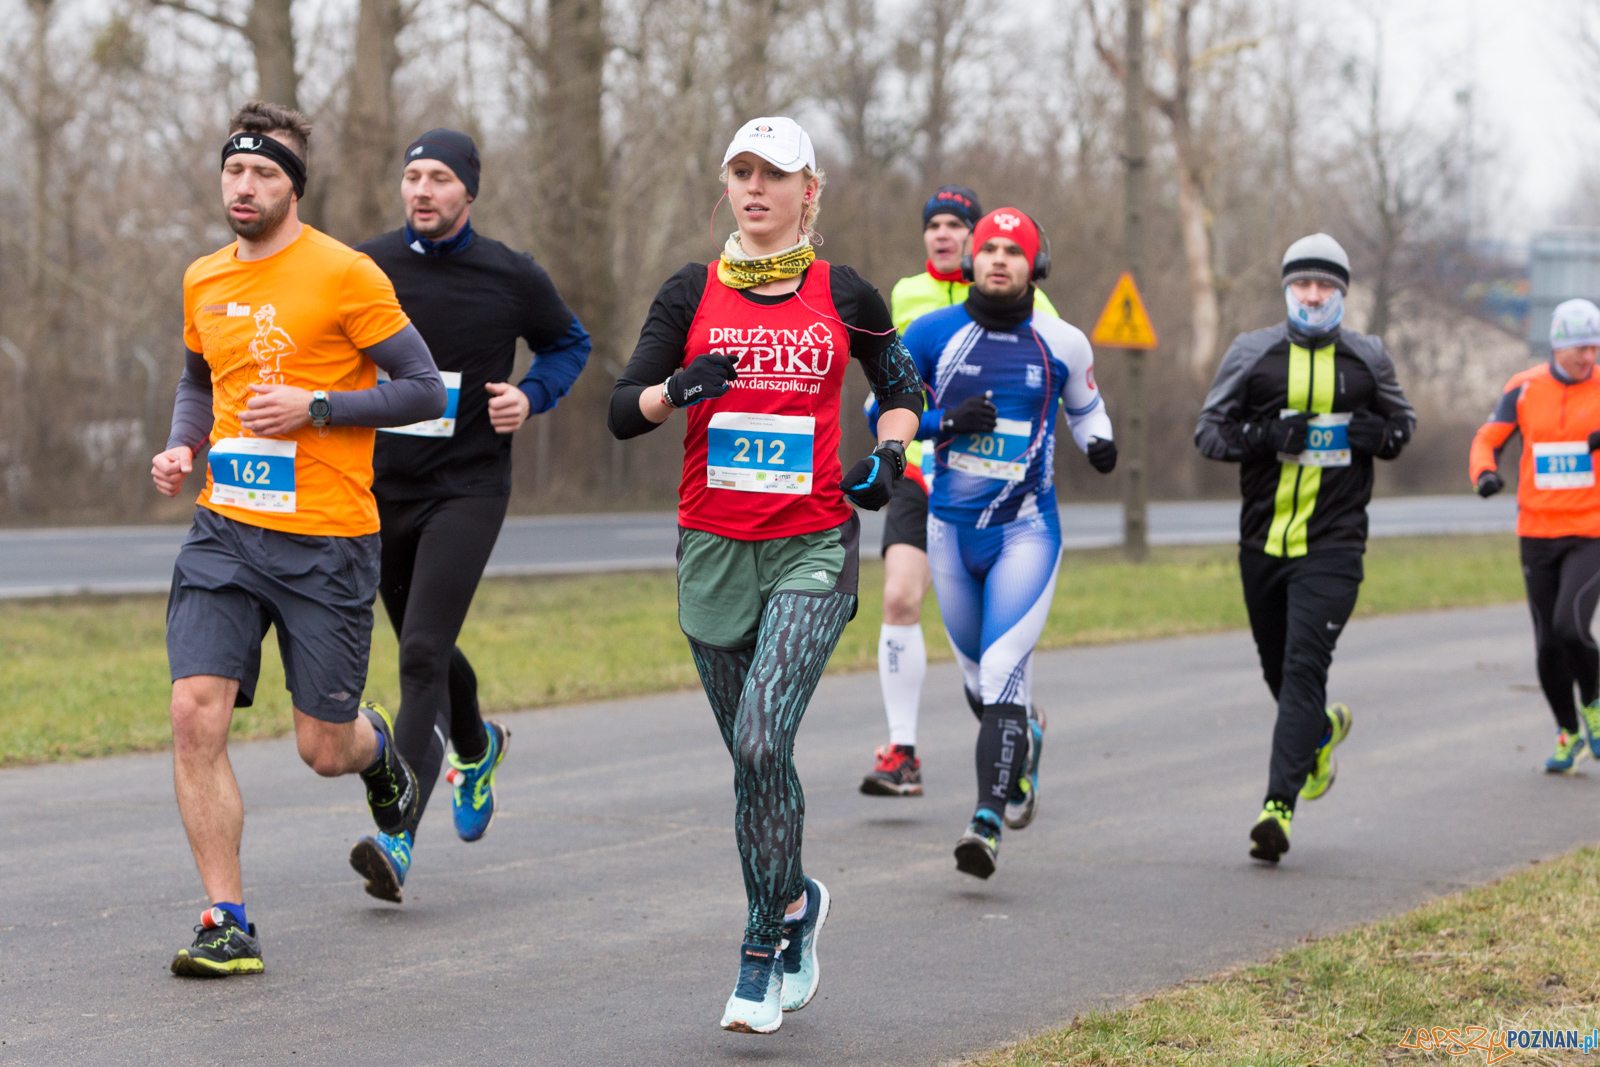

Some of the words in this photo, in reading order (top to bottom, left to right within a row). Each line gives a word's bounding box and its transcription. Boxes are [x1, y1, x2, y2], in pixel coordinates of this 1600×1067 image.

[227, 302, 250, 317] Man
[709, 325, 814, 345] DRUŻYNA
[686, 384, 703, 398] asics
[722, 378, 821, 395] ww.darszpiku.pl
[733, 437, 786, 465] 212
[967, 433, 1005, 457] 201
[230, 459, 270, 485] 162
[991, 718, 1024, 799] Kalenji
